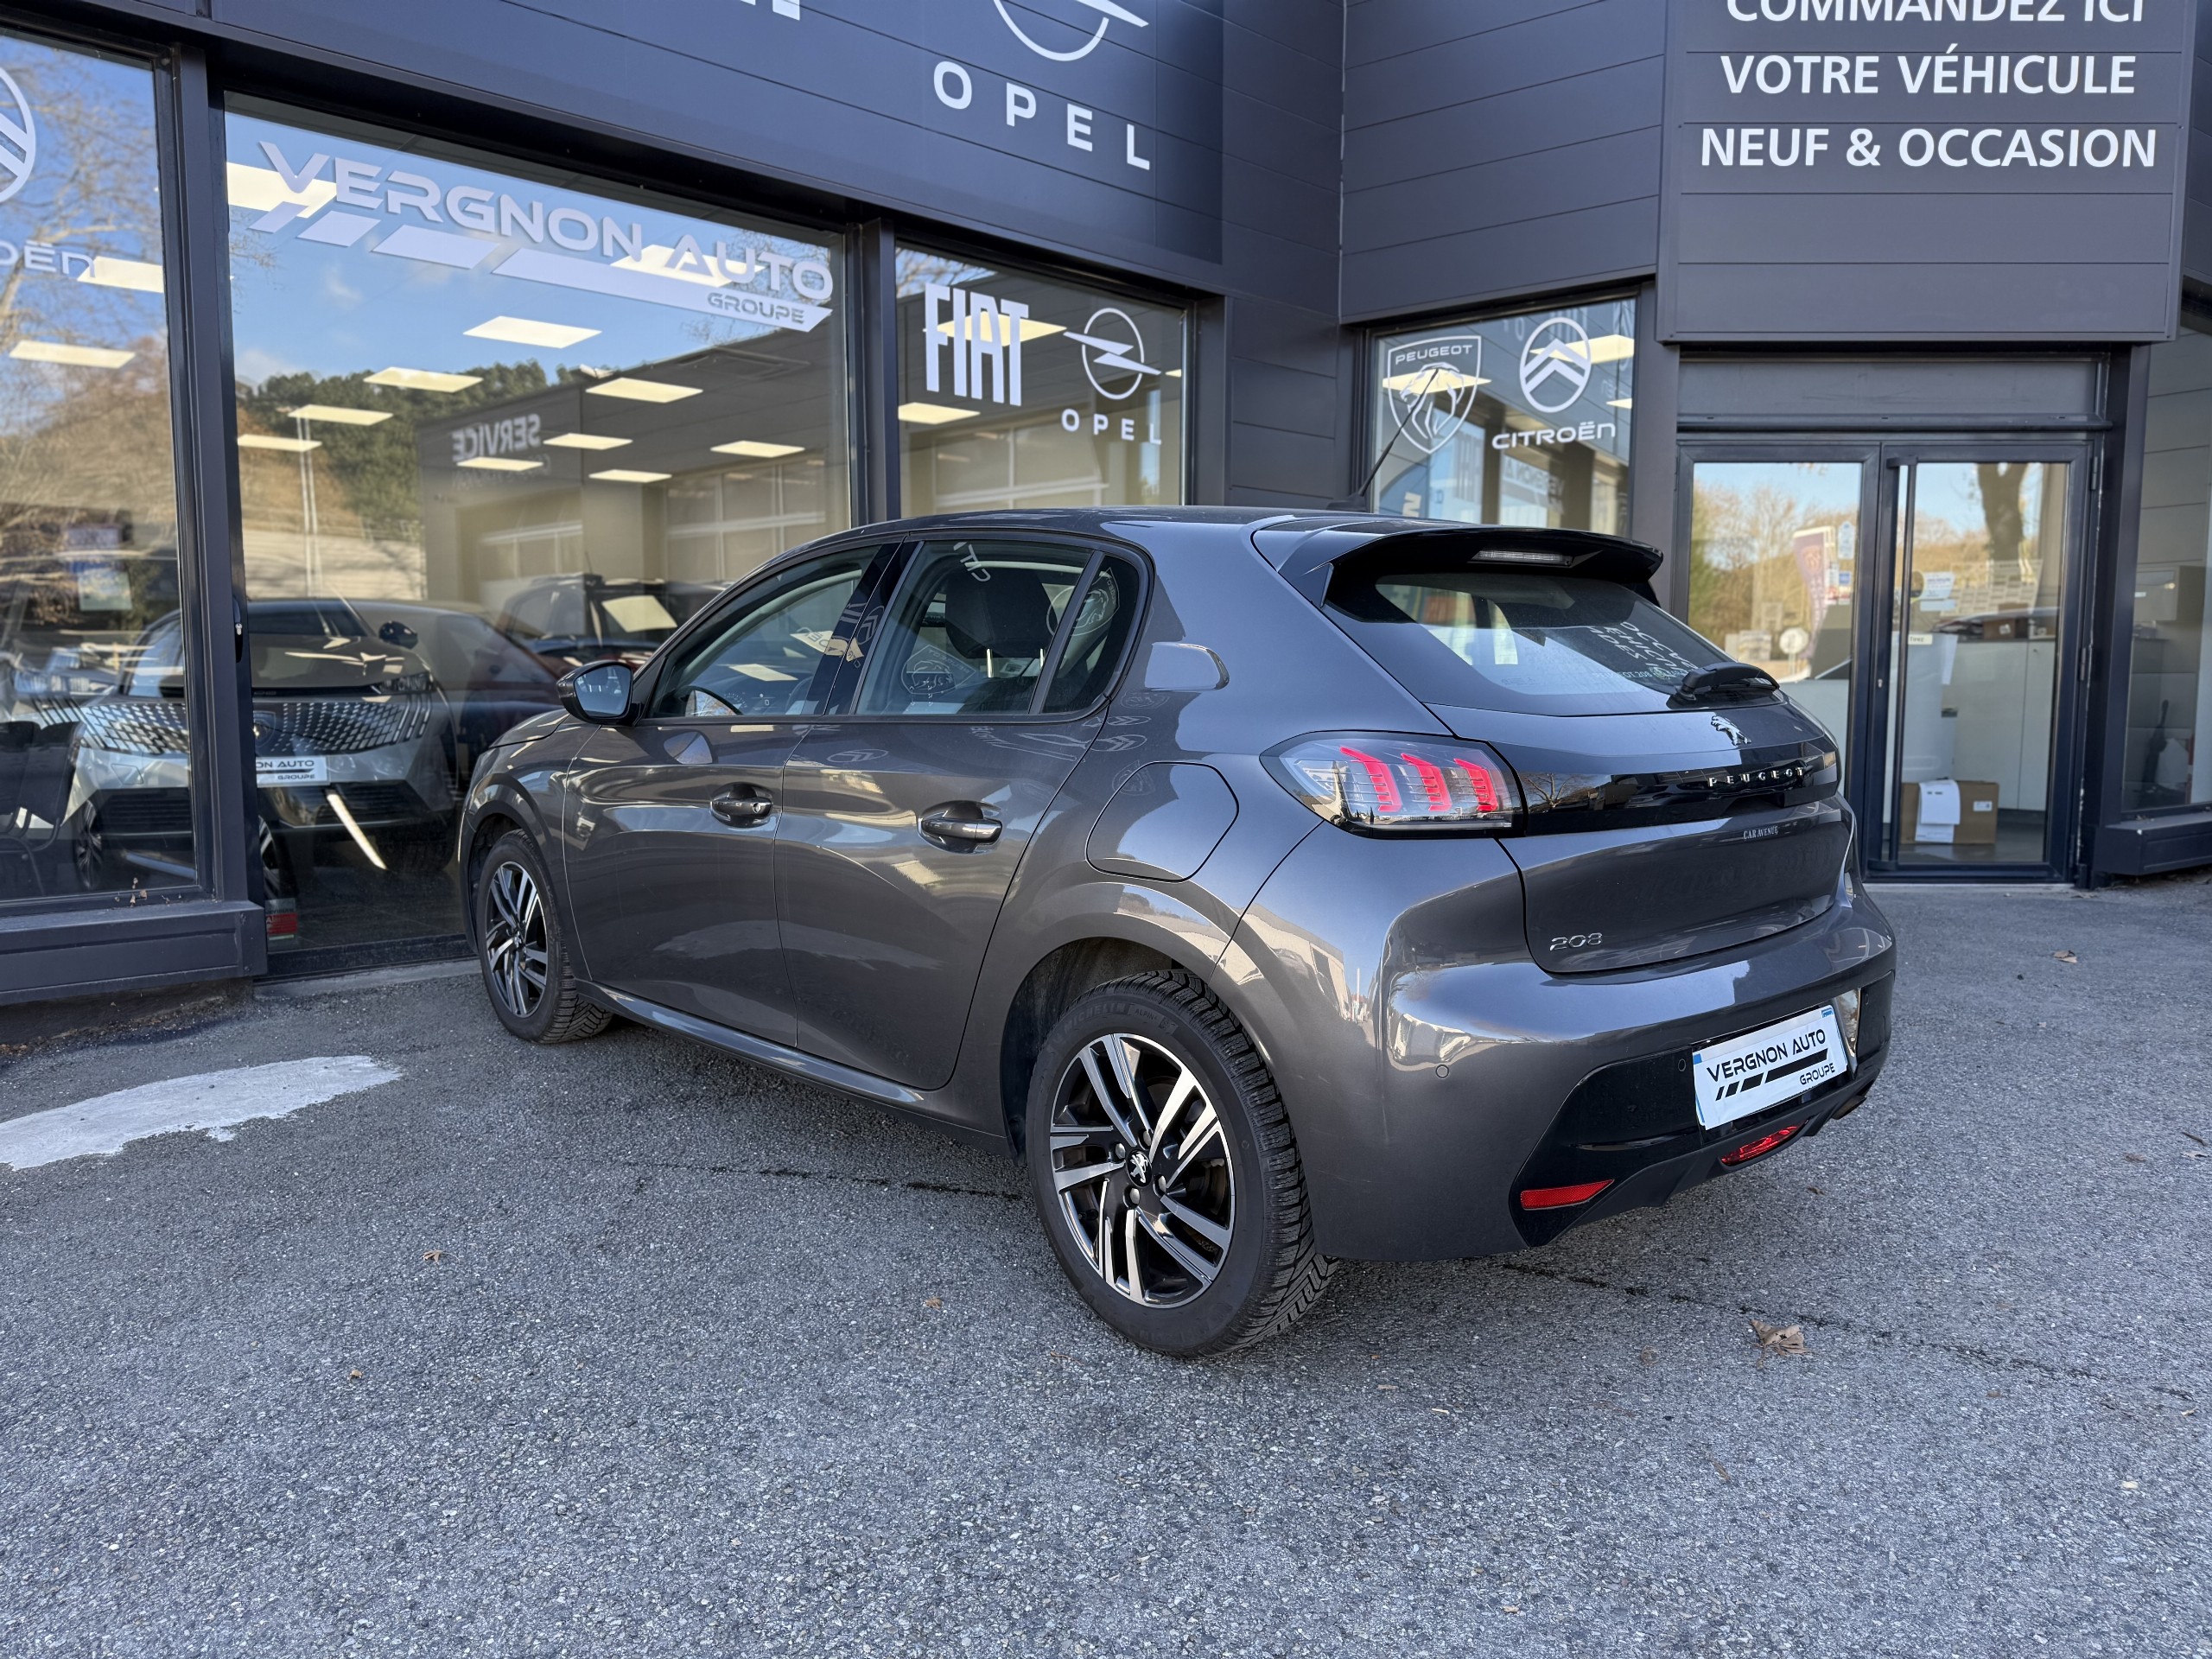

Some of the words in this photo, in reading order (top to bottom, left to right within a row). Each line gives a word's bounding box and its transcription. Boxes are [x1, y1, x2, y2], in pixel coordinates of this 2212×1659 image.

[1726, 0, 2064, 22] COMMANDEZ
[1720, 55, 1879, 94] VOTRE
[1897, 43, 2137, 94] VÉHICULE
[933, 60, 1150, 171] OPEL
[1701, 128, 1829, 167] NEUF
[1846, 128, 1881, 167] &
[1898, 128, 2157, 168] OCCASION
[258, 140, 643, 262] VERGNON
[663, 233, 834, 302] AUTO
[707, 290, 805, 325] GROUPE
[925, 283, 1029, 406] FIAT
[1395, 344, 1472, 365] PEUGEOT
[1061, 408, 1161, 445] OPEL
[276, 760, 315, 768] AUTO
[1707, 766, 1804, 787] PEUGEOT
[1744, 830, 1757, 840] CAR
[1549, 932, 1603, 951] 208
[1707, 1042, 1788, 1083] VERGNON
[1793, 1028, 1826, 1056] AUTO
[1799, 1062, 1836, 1085] GROUPE
